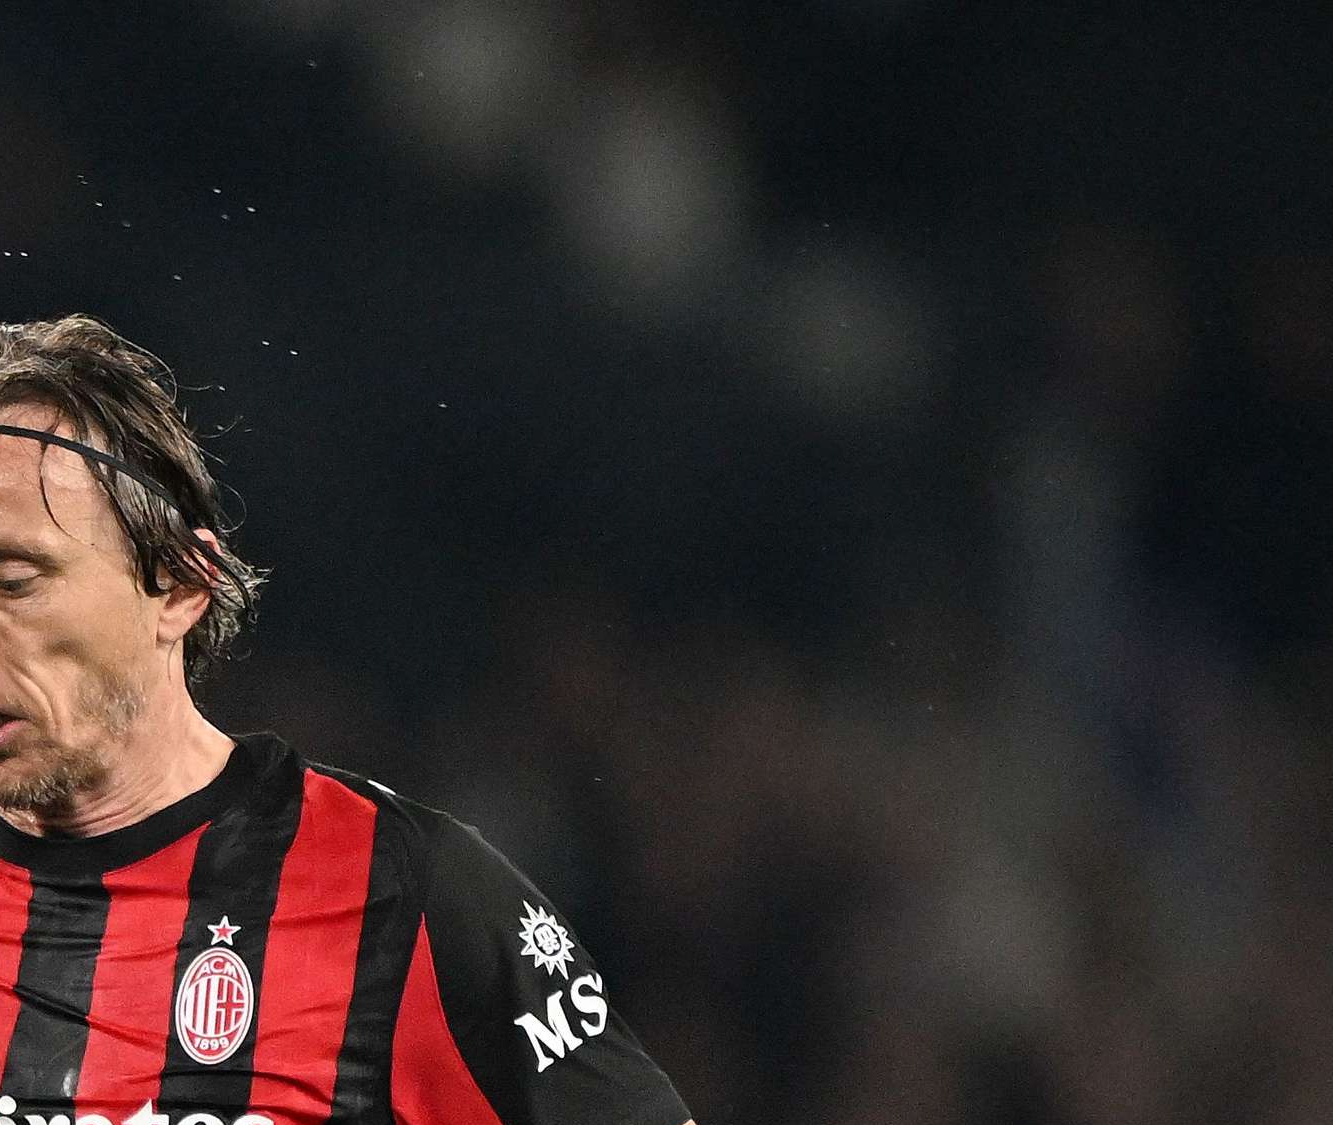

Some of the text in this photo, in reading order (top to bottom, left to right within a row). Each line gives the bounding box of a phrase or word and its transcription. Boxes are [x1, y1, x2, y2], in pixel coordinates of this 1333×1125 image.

[195, 957, 239, 979] ACM
[513, 971, 609, 1074] MS
[194, 1037, 230, 1051] 1899
